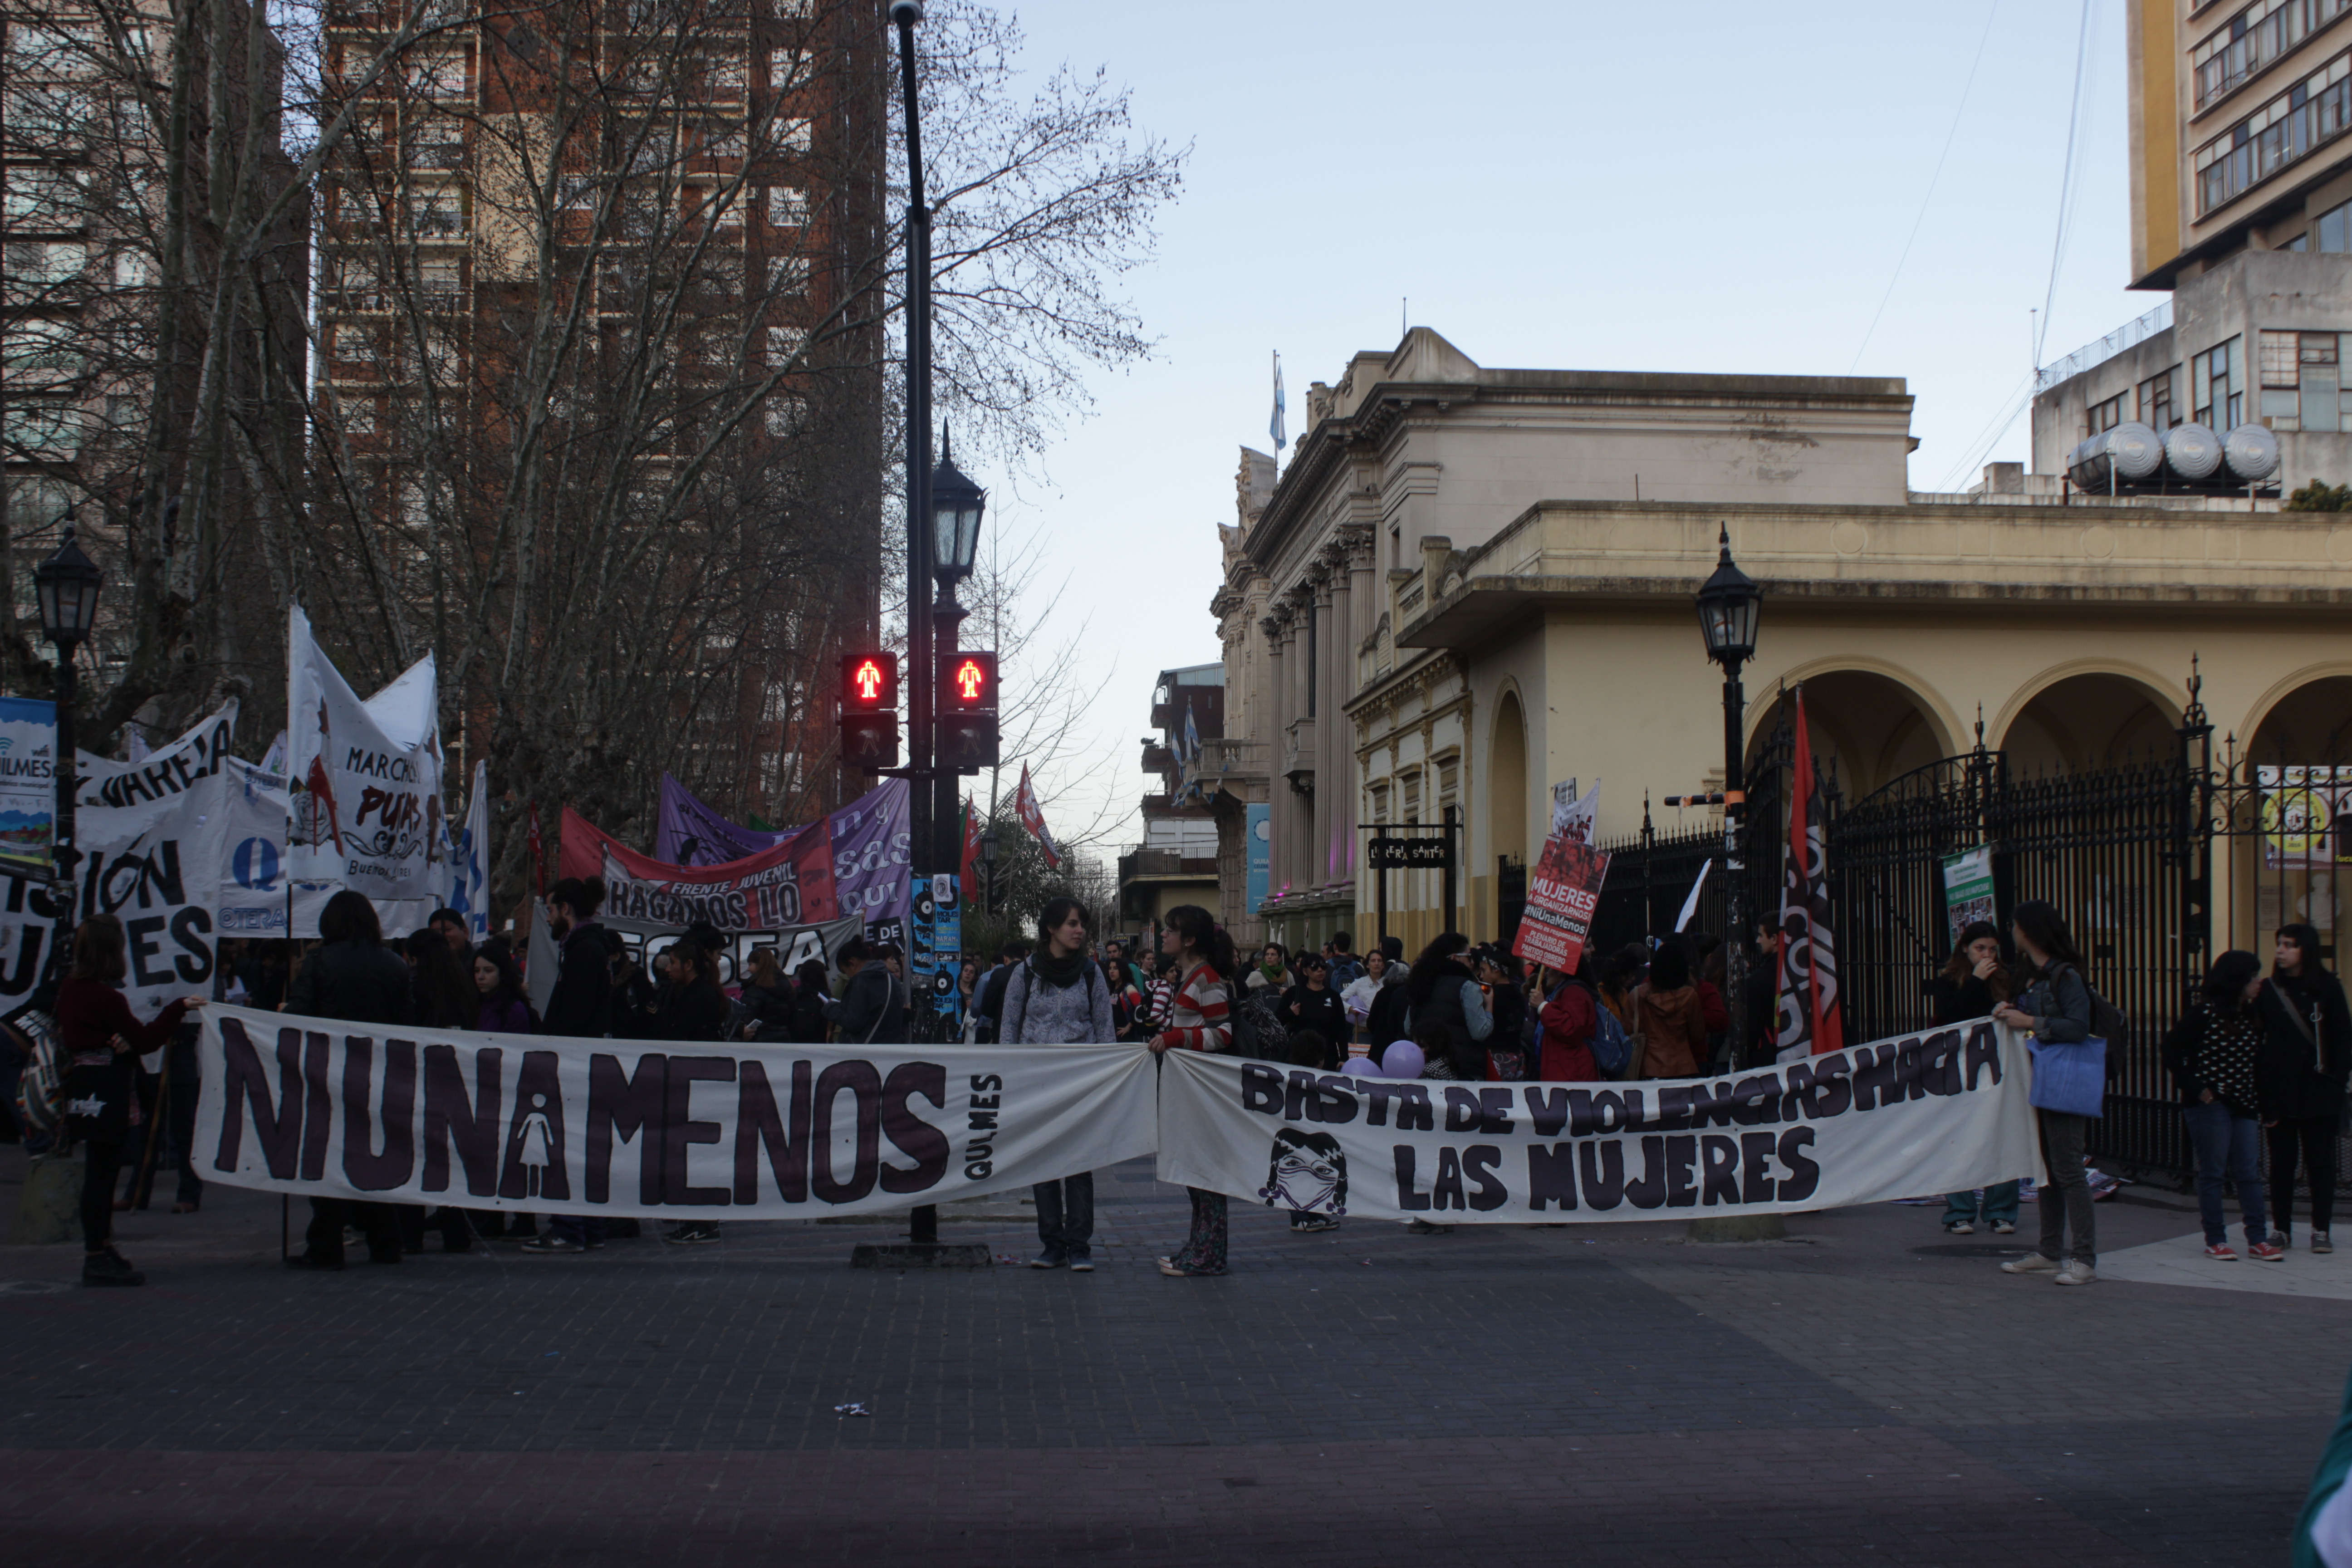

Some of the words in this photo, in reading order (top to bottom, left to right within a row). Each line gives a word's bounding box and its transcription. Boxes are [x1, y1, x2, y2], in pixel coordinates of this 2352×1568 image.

[0, 757, 51, 778] ILMES
[232, 837, 279, 892] Q
[1371, 845, 1408, 860] LIRERIA
[671, 880, 731, 895] FRENTE
[737, 862, 797, 890] JUVENIL
[608, 878, 750, 930] HAGAMOS
[757, 881, 801, 928] LO
[1530, 876, 1597, 911] MUJERES
[1524, 904, 1586, 935] #NiUnaMenos
[1527, 893, 1534, 902] A
[1534, 895, 1592, 921] ORGANIZARNOS!
[879, 924, 901, 940] DE
[1527, 919, 1543, 930] Estado
[1550, 928, 1582, 944] responsable
[1529, 930, 1558, 945] PLENARIO
[1558, 940, 1566, 949] DE
[916, 954, 934, 963] MARA
[1521, 943, 1543, 956] PARTIDO
[1544, 951, 1565, 965] OBRERO
[1524, 935, 1568, 957] TRABAJADORAS
[1521, 951, 1536, 960] FRENTE
[1542, 957, 1562, 969] IZQUIERDA
[1241, 1063, 1434, 1131] BASTA
[1445, 1087, 1515, 1135] DE
[1525, 1048, 1851, 1137] VIOLENCIAS
[1852, 1022, 2001, 1112] HACIA
[214, 1016, 330, 1181] NI
[342, 1035, 571, 1200] UNA
[584, 1053, 950, 1205] MENOS
[1393, 1144, 1508, 1211] LAS
[1527, 1126, 1819, 1211] MUJERES
